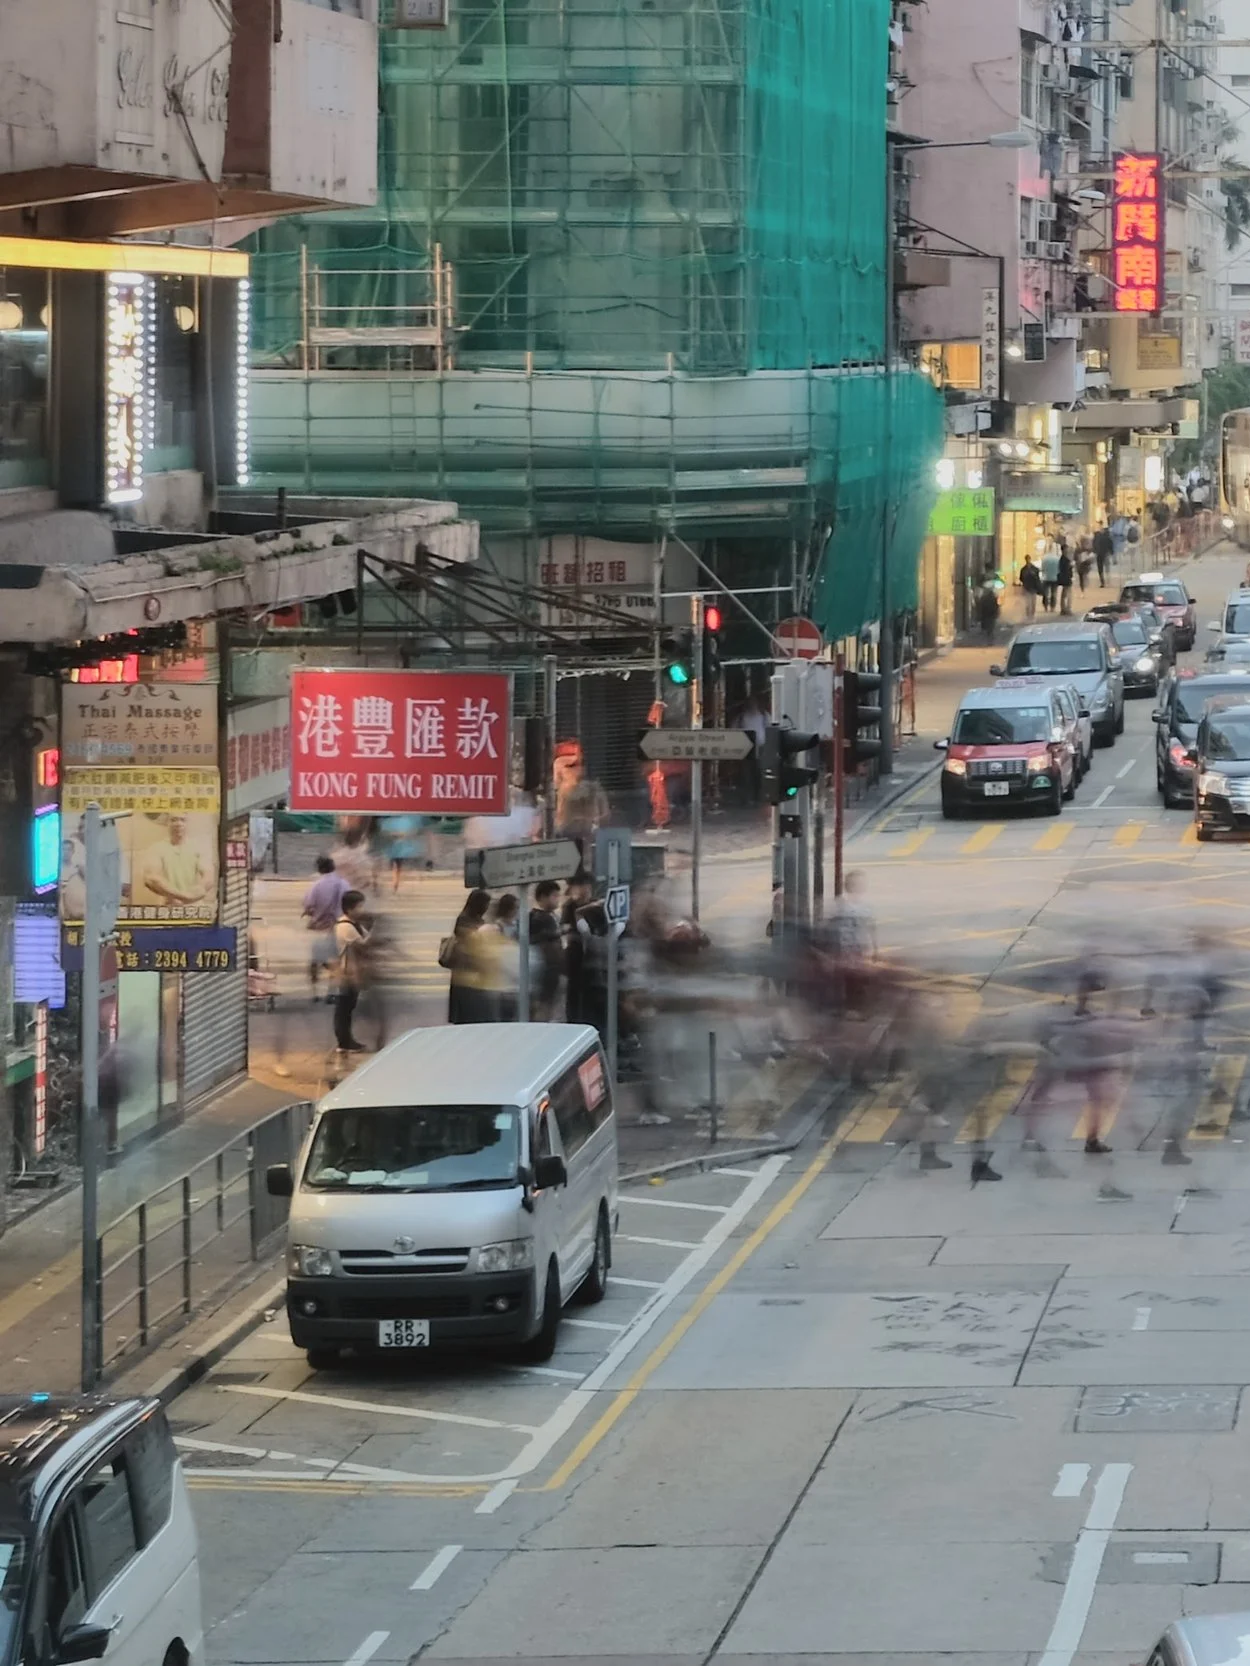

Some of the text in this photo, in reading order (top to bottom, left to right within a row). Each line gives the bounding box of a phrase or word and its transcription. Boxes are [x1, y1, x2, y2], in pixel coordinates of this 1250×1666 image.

[78, 704, 203, 721] Thai Massage
[298, 694, 499, 760] 港豐匯款
[298, 772, 498, 800] KONG FUNG REMIT
[154, 951, 187, 968] 2394
[196, 951, 230, 968] 4779
[394, 1320, 414, 1333] RR
[383, 1333, 426, 1346] 3892
